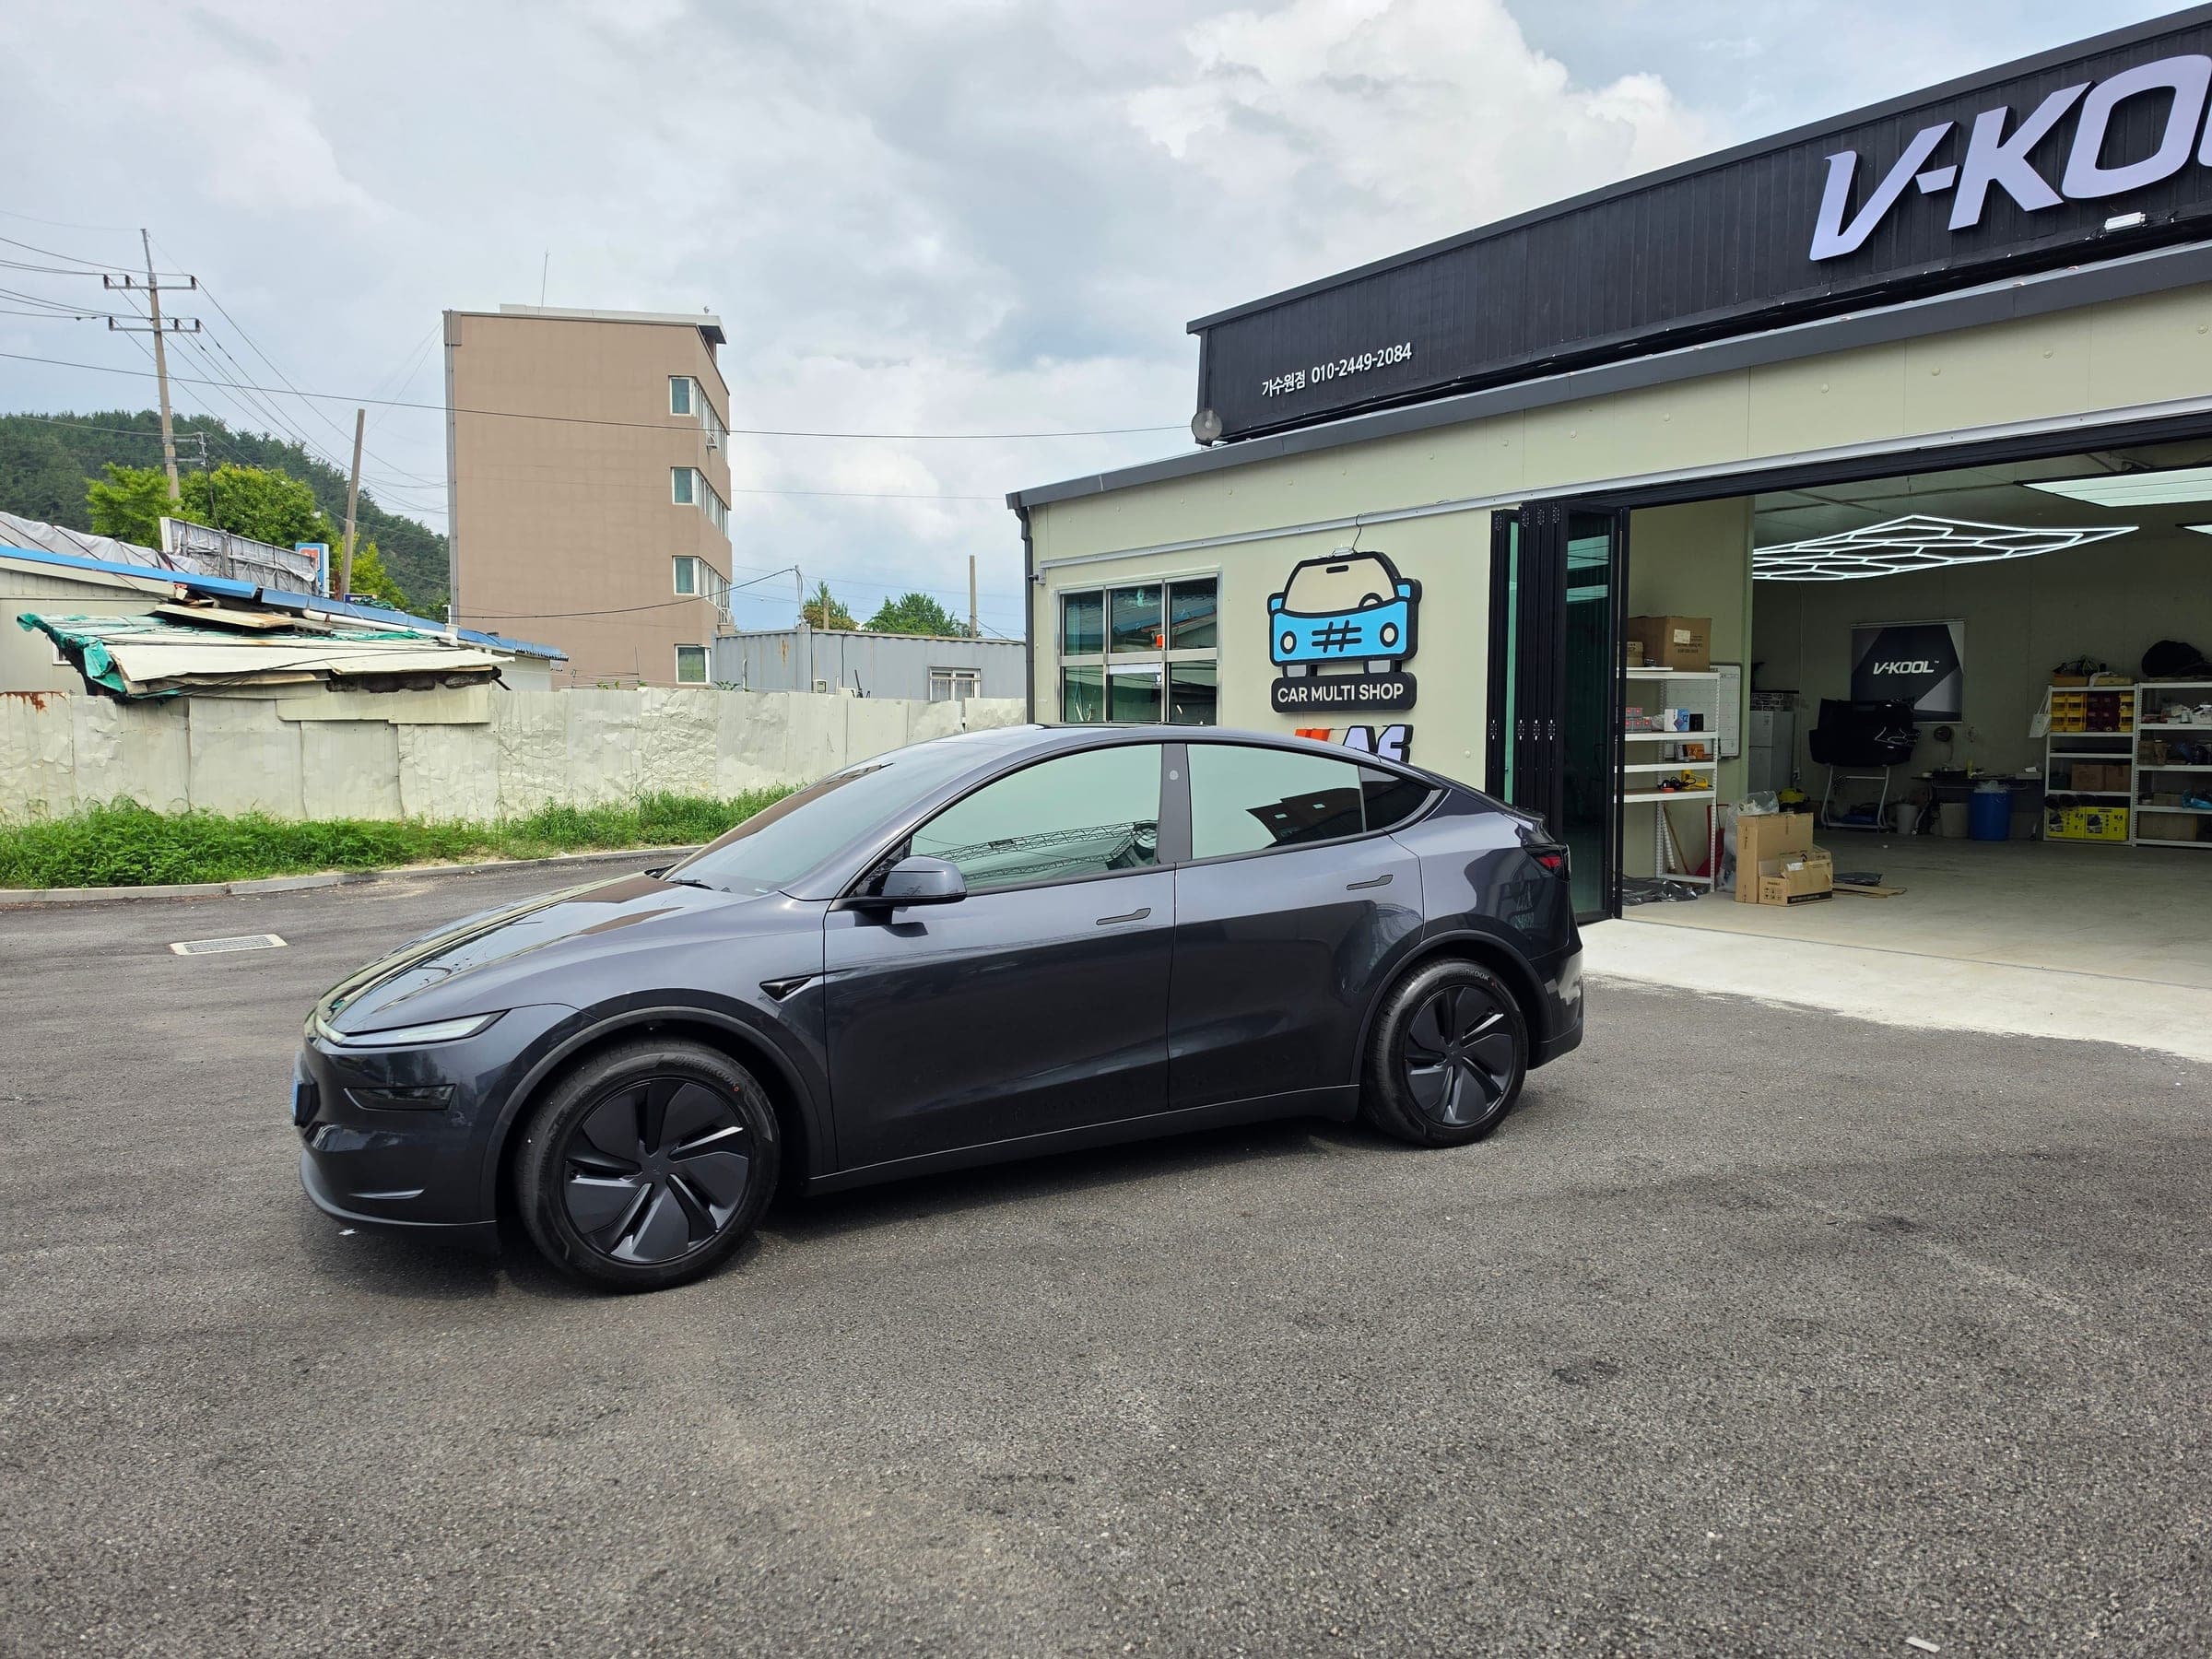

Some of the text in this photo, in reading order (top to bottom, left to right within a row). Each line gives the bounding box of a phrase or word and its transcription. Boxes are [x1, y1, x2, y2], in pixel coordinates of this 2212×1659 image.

[1809, 54, 2212, 262] V-KO
[1262, 342, 1412, 397] 가수원점 010-2449-2084
[1873, 661, 1935, 675] V-KOOL
[1277, 683, 1404, 703] CAR MULTI SHOP
